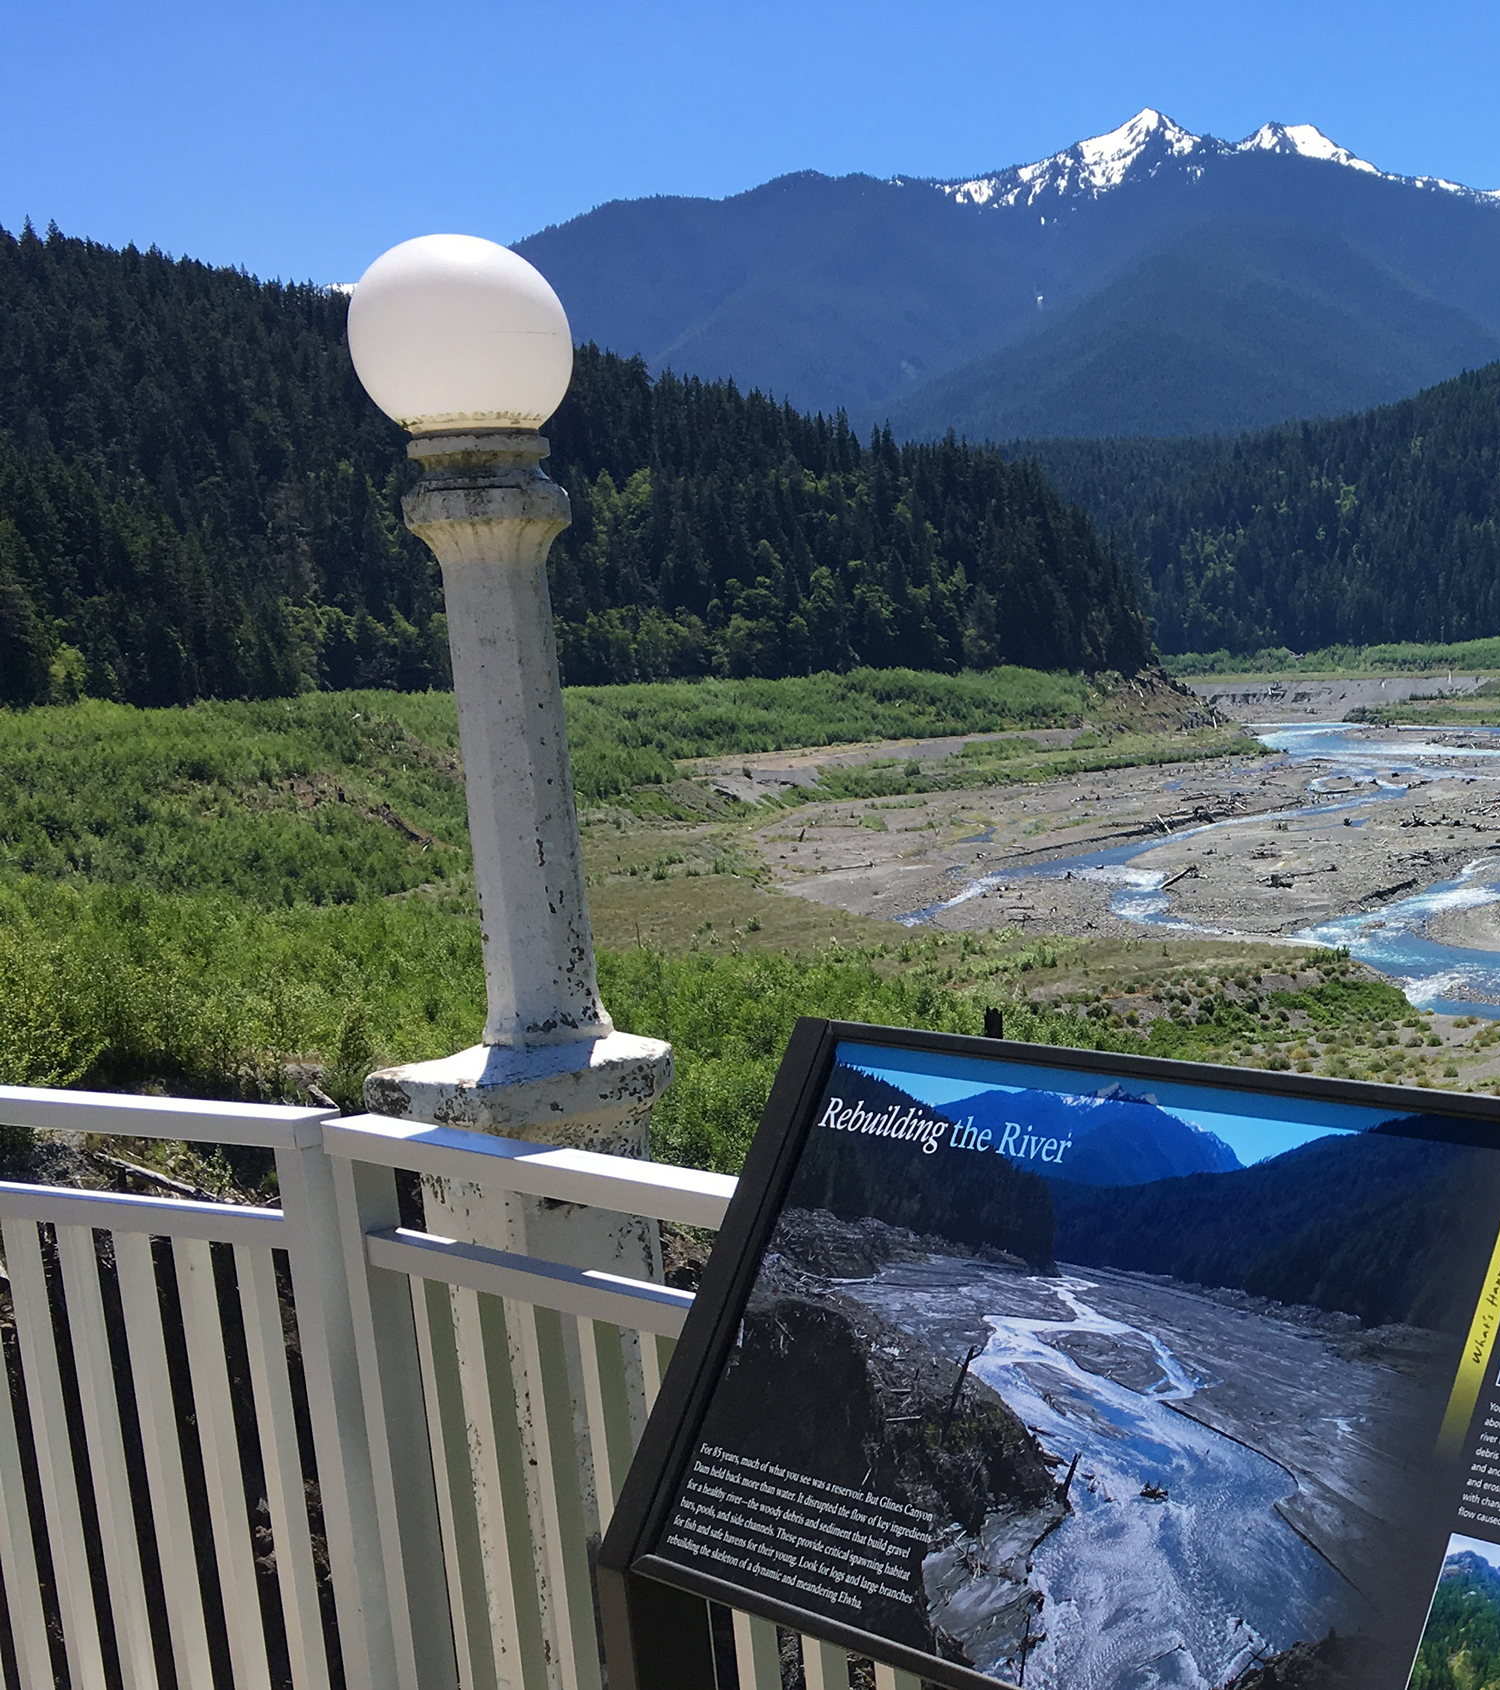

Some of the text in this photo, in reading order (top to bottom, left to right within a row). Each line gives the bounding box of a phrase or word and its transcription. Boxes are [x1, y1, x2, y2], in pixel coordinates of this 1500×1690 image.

[817, 1097, 1072, 1164] Rebuilding the River
[1471, 1314, 1494, 1365] What's
[1480, 1432, 1498, 1443] river
[1475, 1447, 1499, 1460] debris
[1471, 1463, 1487, 1473] and
[700, 1443, 933, 1522] For 85 years, much of what you see was a reservoir. But Glines Canyon
[1466, 1478, 1483, 1487] and
[693, 1460, 932, 1543] Dam held back more than water. It disrupted the flow of key ingredients
[1462, 1493, 1480, 1503] with
[687, 1478, 698, 1490] for
[702, 1483, 727, 1502] healthy
[759, 1504, 783, 1520] woody
[782, 1509, 805, 1524] debris
[804, 1518, 820, 1529] and
[819, 1522, 852, 1540] sediment
[851, 1531, 867, 1544] that
[867, 1535, 888, 1551] build
[885, 1544, 911, 1558] gravel
[1458, 1506, 1476, 1518] flow
